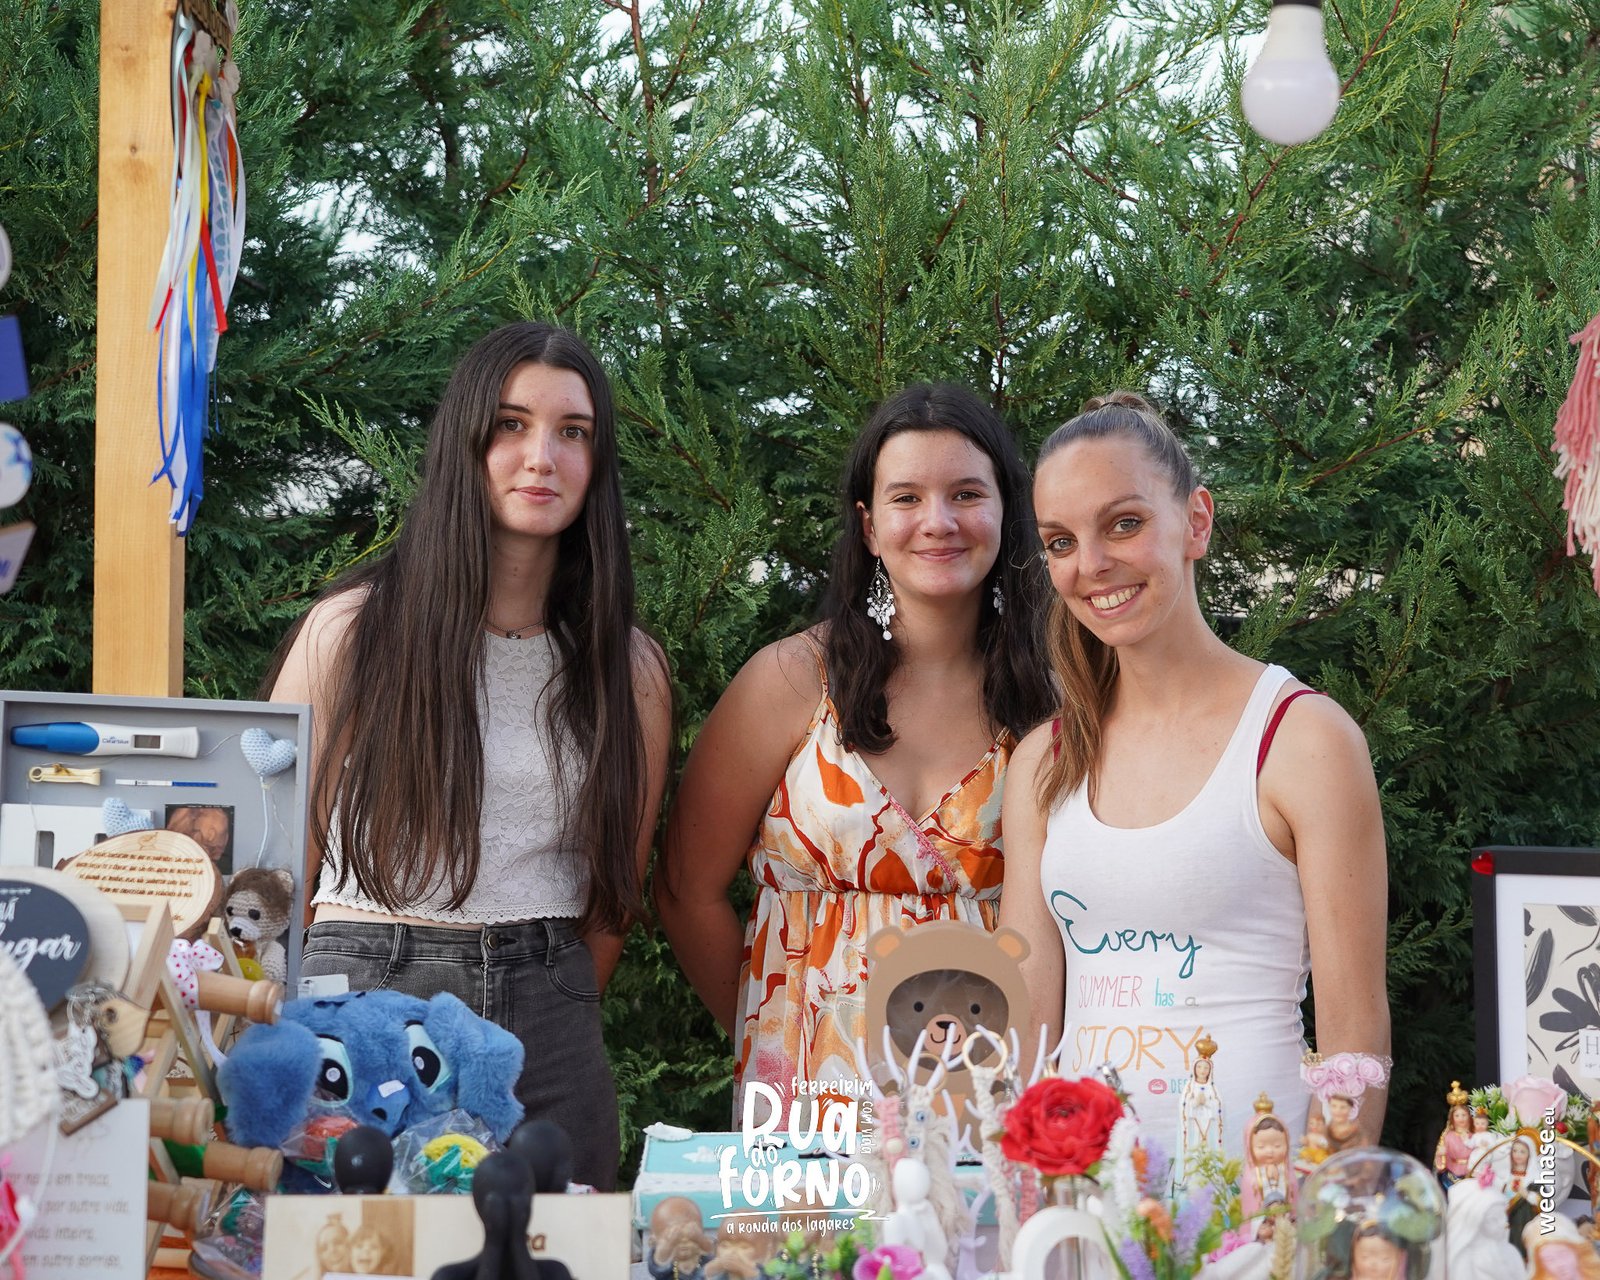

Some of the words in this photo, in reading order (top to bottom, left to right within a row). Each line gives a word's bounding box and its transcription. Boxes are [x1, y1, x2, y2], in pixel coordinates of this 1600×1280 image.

[1050, 889, 1202, 979] Every
[1078, 974, 1143, 1008] SUMMER
[1154, 977, 1175, 1008] has
[1185, 996, 1200, 1008] a
[1072, 1025, 1204, 1074] STORY
